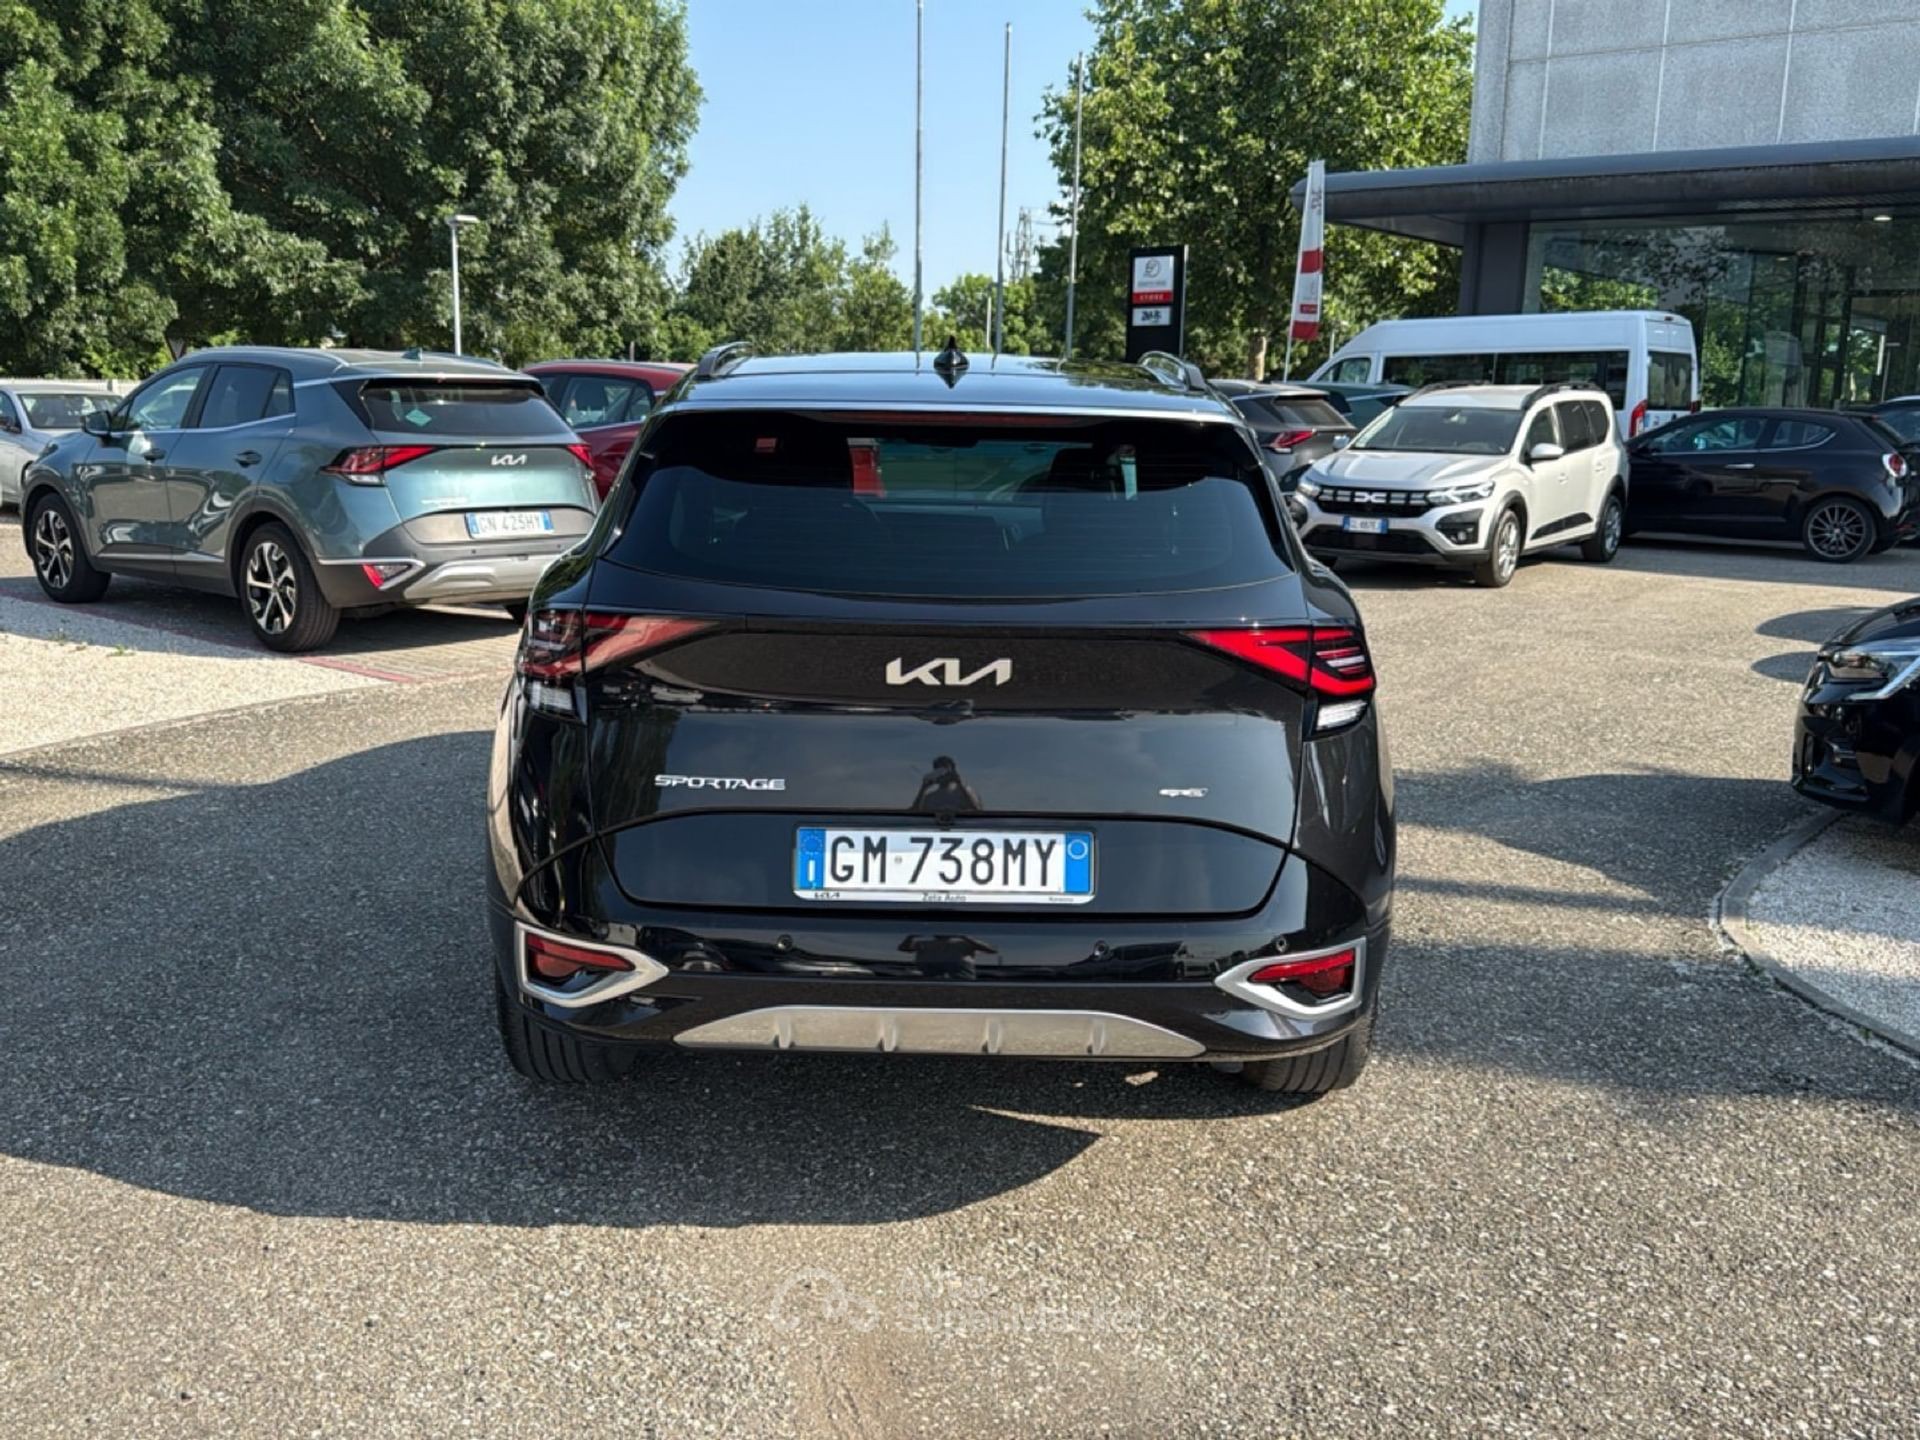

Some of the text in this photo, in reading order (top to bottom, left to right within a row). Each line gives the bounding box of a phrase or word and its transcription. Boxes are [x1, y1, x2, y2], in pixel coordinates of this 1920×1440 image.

[491, 454, 527, 465] KIA
[885, 656, 1013, 687] KIA
[654, 773, 787, 792] SPORTAGE
[829, 835, 1058, 887] GM 738MY
[921, 892, 967, 903] Zeta Auto
